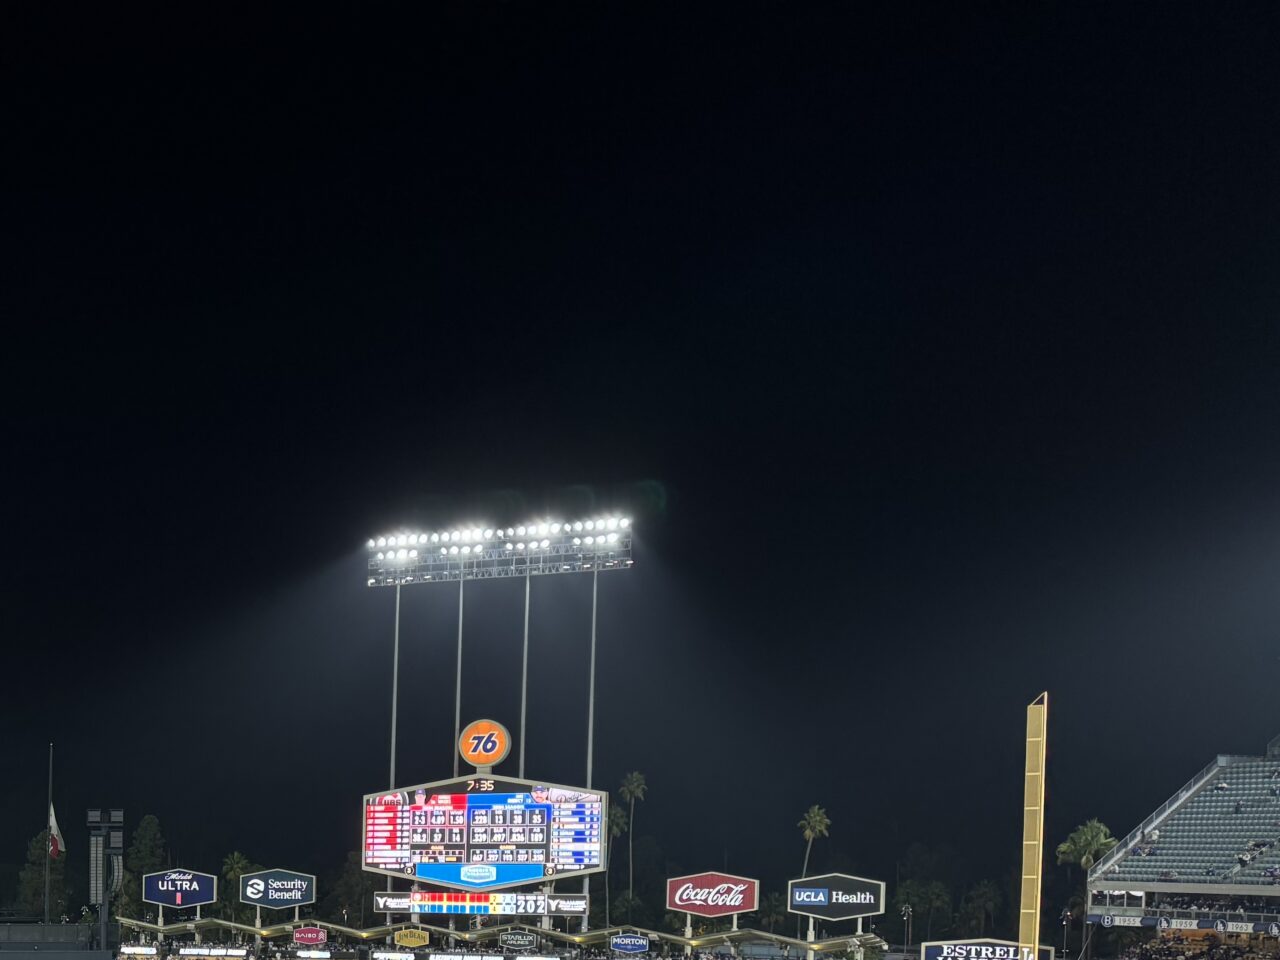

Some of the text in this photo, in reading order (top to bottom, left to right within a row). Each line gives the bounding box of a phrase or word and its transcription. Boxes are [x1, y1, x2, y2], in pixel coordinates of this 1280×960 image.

[469, 732, 499, 754] 76
[467, 781, 494, 791] 7:35
[158, 881, 199, 891] ULTRA
[268, 879, 307, 892] Security
[268, 890, 303, 899] Benefit
[674, 882, 749, 906] Coca-Cola
[795, 890, 874, 904] UCLA Health
[517, 900, 545, 913] 2 0 2
[397, 931, 426, 942] JIM BEAM
[612, 937, 647, 946] MORTON
